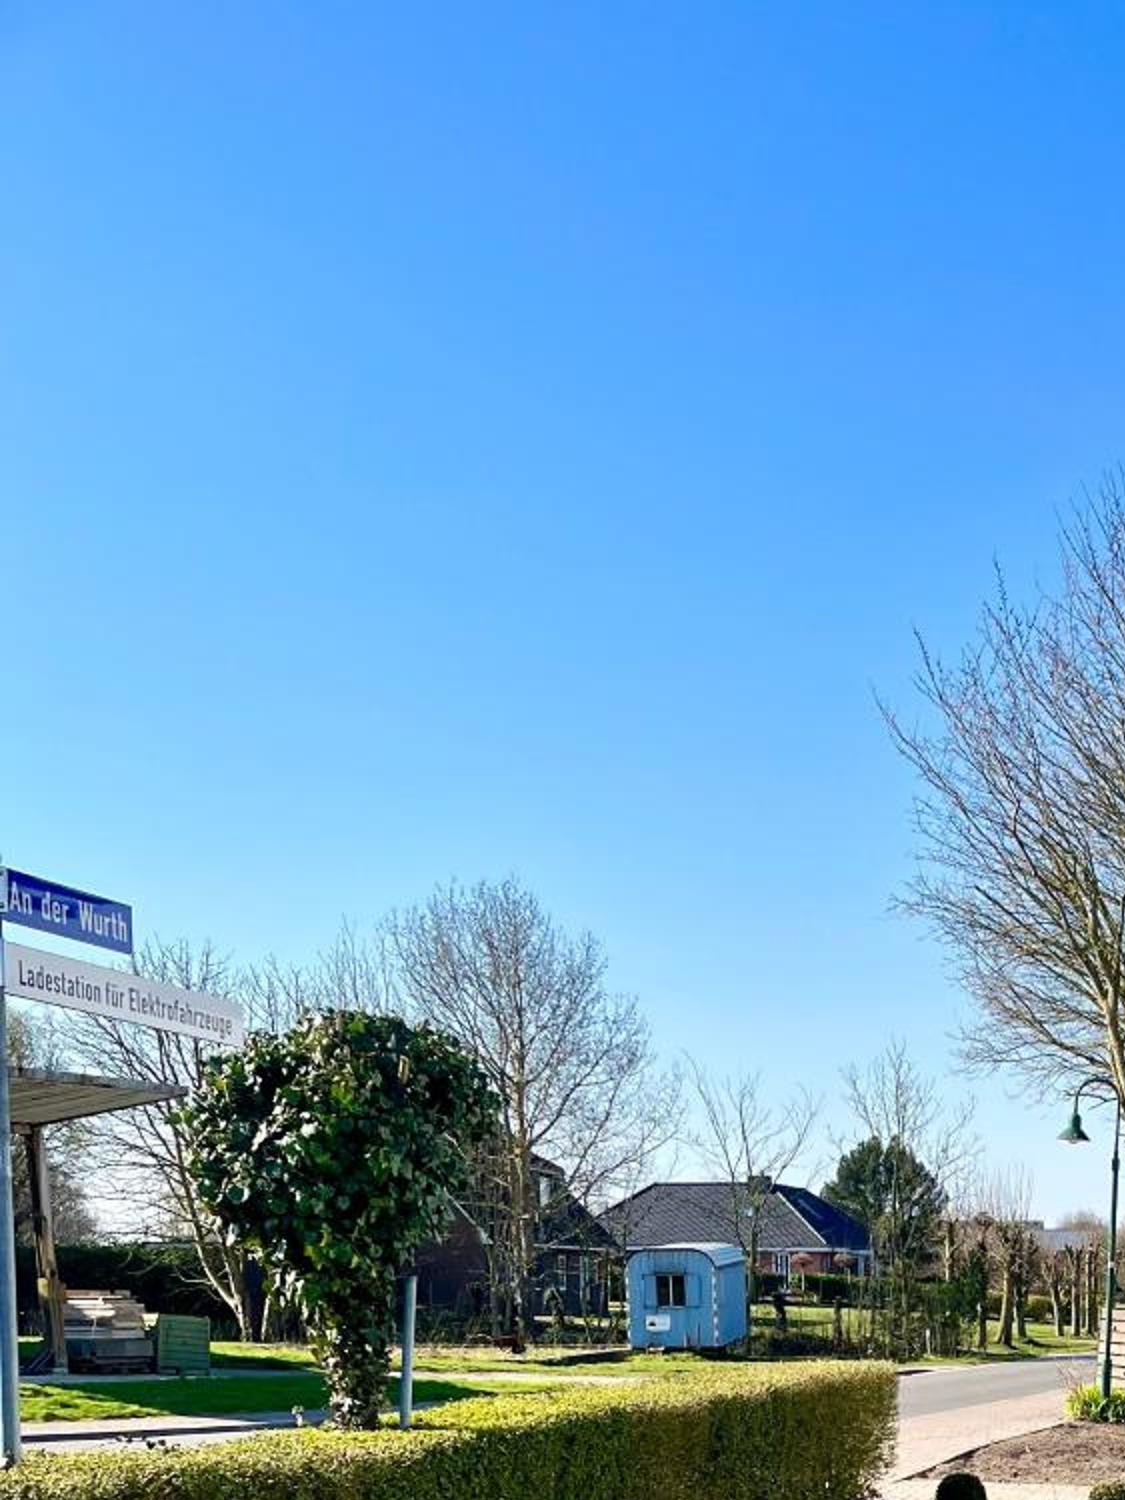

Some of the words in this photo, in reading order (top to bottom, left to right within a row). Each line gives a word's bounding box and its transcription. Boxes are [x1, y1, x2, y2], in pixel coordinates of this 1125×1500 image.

[9, 881, 33, 914] An
[41, 890, 69, 925] der
[78, 900, 128, 943] Wurth
[18, 959, 102, 1000] Ladestation
[105, 980, 125, 1009] für
[128, 987, 233, 1038] Elektrofahrzeuge
